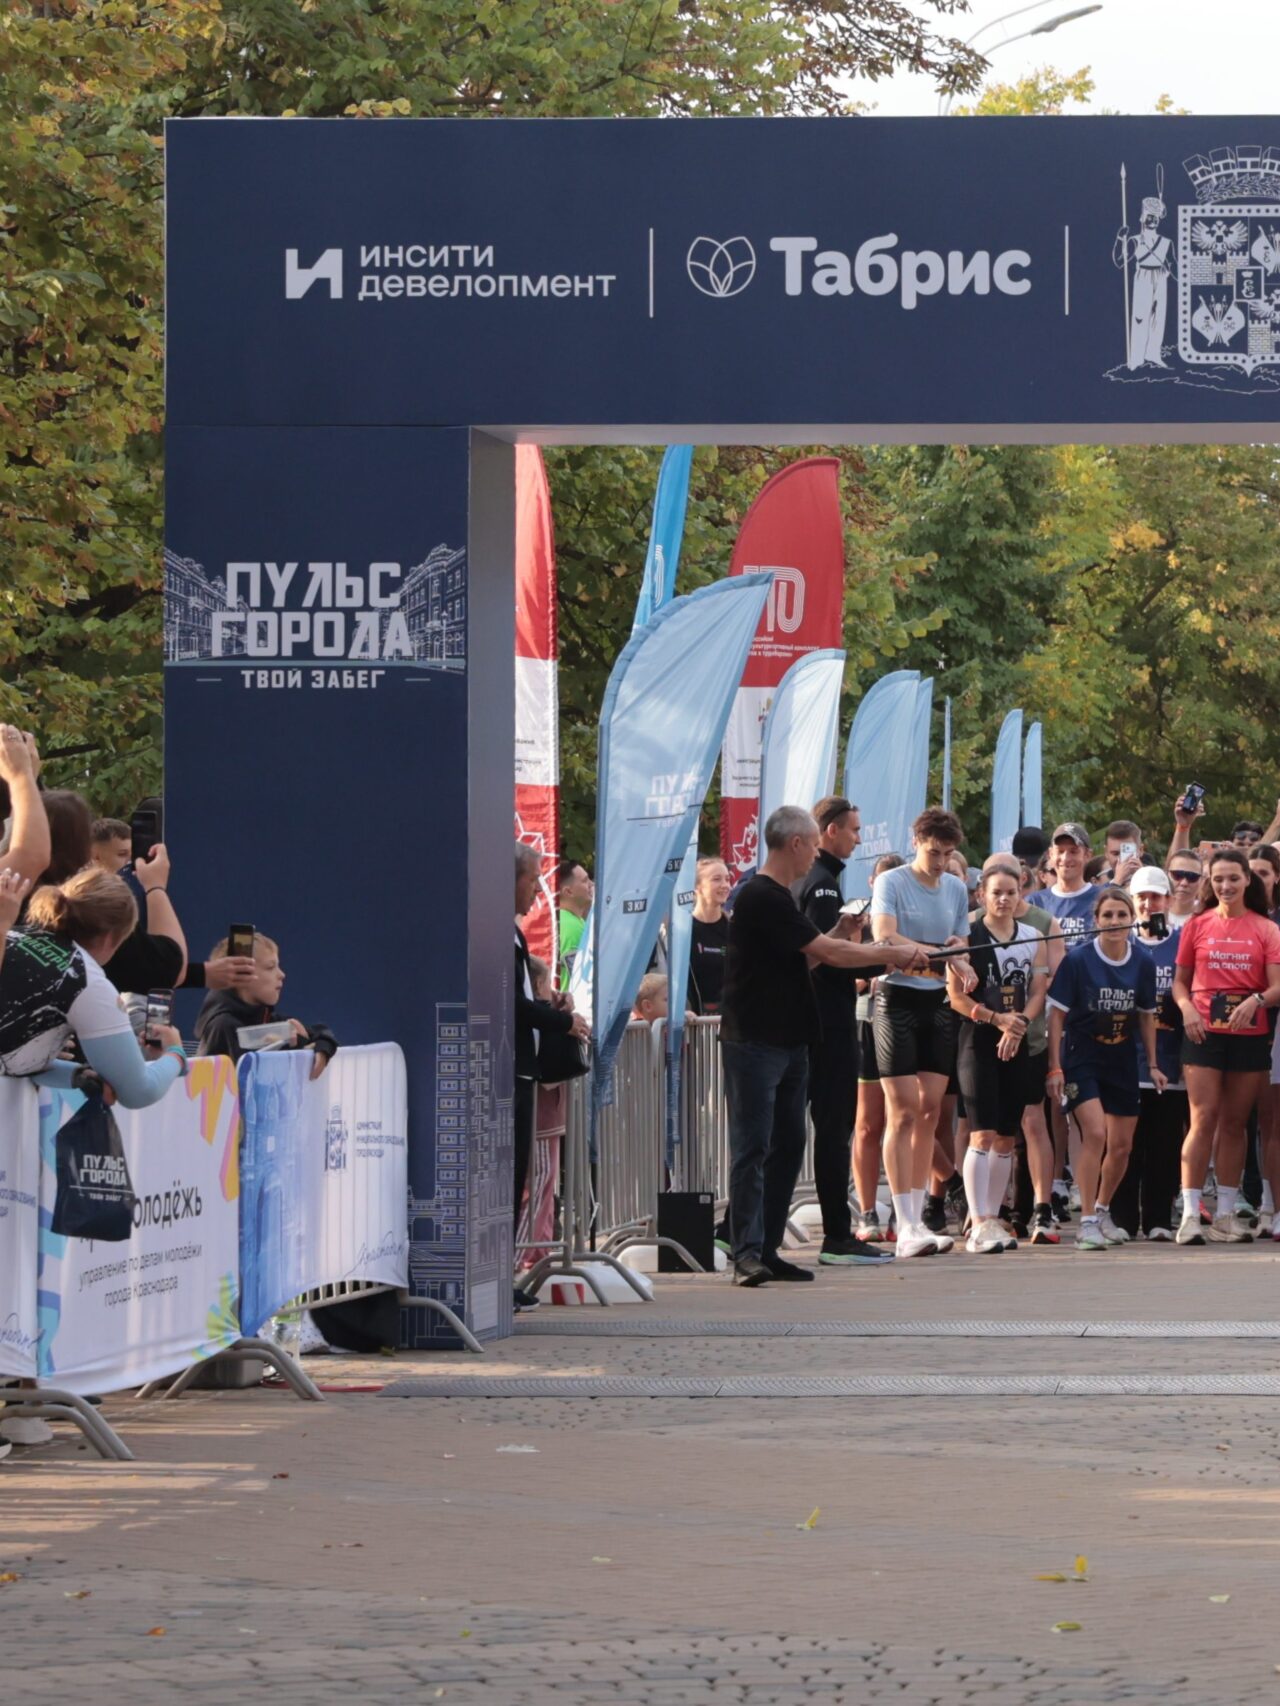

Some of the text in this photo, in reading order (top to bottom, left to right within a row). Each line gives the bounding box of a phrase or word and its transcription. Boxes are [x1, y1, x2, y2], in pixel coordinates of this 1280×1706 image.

[769, 232, 1032, 309] Табрис
[226, 562, 401, 608] ПУЛЬС
[211, 611, 414, 659] ГОРОДА
[241, 668, 385, 688] ТВОЙ ЗАБЕГ
[1209, 950, 1251, 960] Магнит
[80, 1168, 127, 1186] ГОРОДА
[83, 1154, 125, 1171] ПУЛЬС
[133, 1180, 202, 1229] олодёжь
